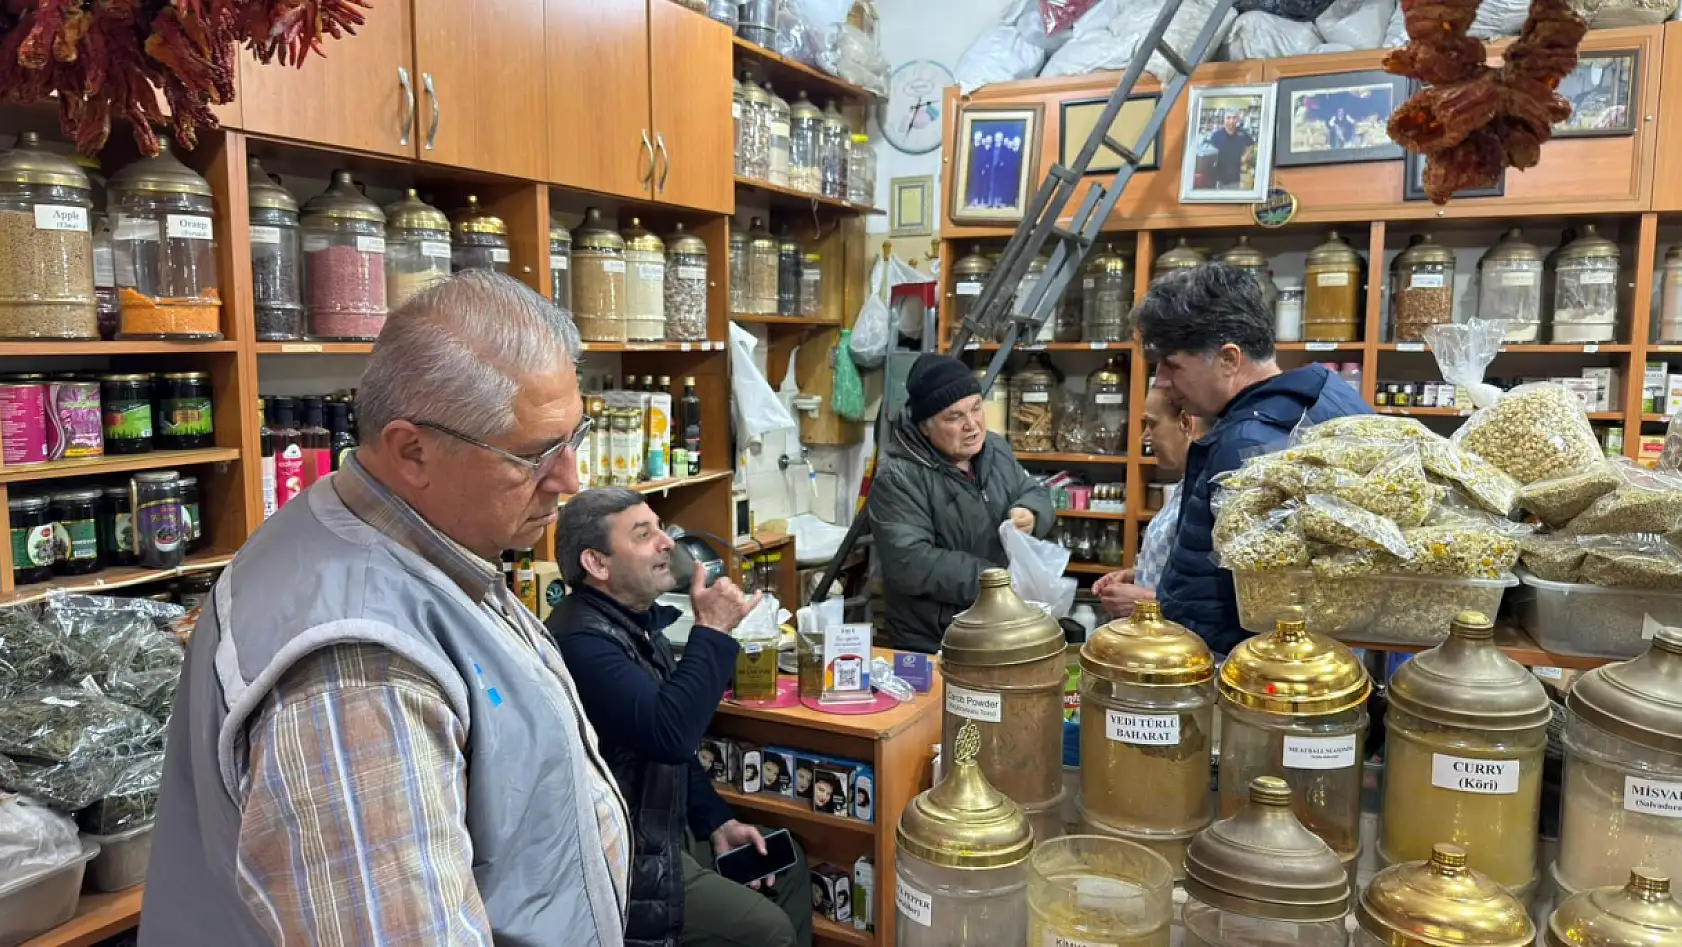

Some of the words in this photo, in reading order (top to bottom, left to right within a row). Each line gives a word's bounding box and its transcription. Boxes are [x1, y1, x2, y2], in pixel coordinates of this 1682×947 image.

[52, 210, 80, 222] Apple
[966, 696, 998, 709] Powder
[1110, 714, 1136, 727] YEDİ
[1139, 717, 1177, 728] TÜRLÜ
[1116, 728, 1171, 741] BAHARAT
[1453, 761, 1505, 775] CURRY
[1459, 776, 1498, 791] (Köri)
[1631, 783, 1682, 800] MİSVA
